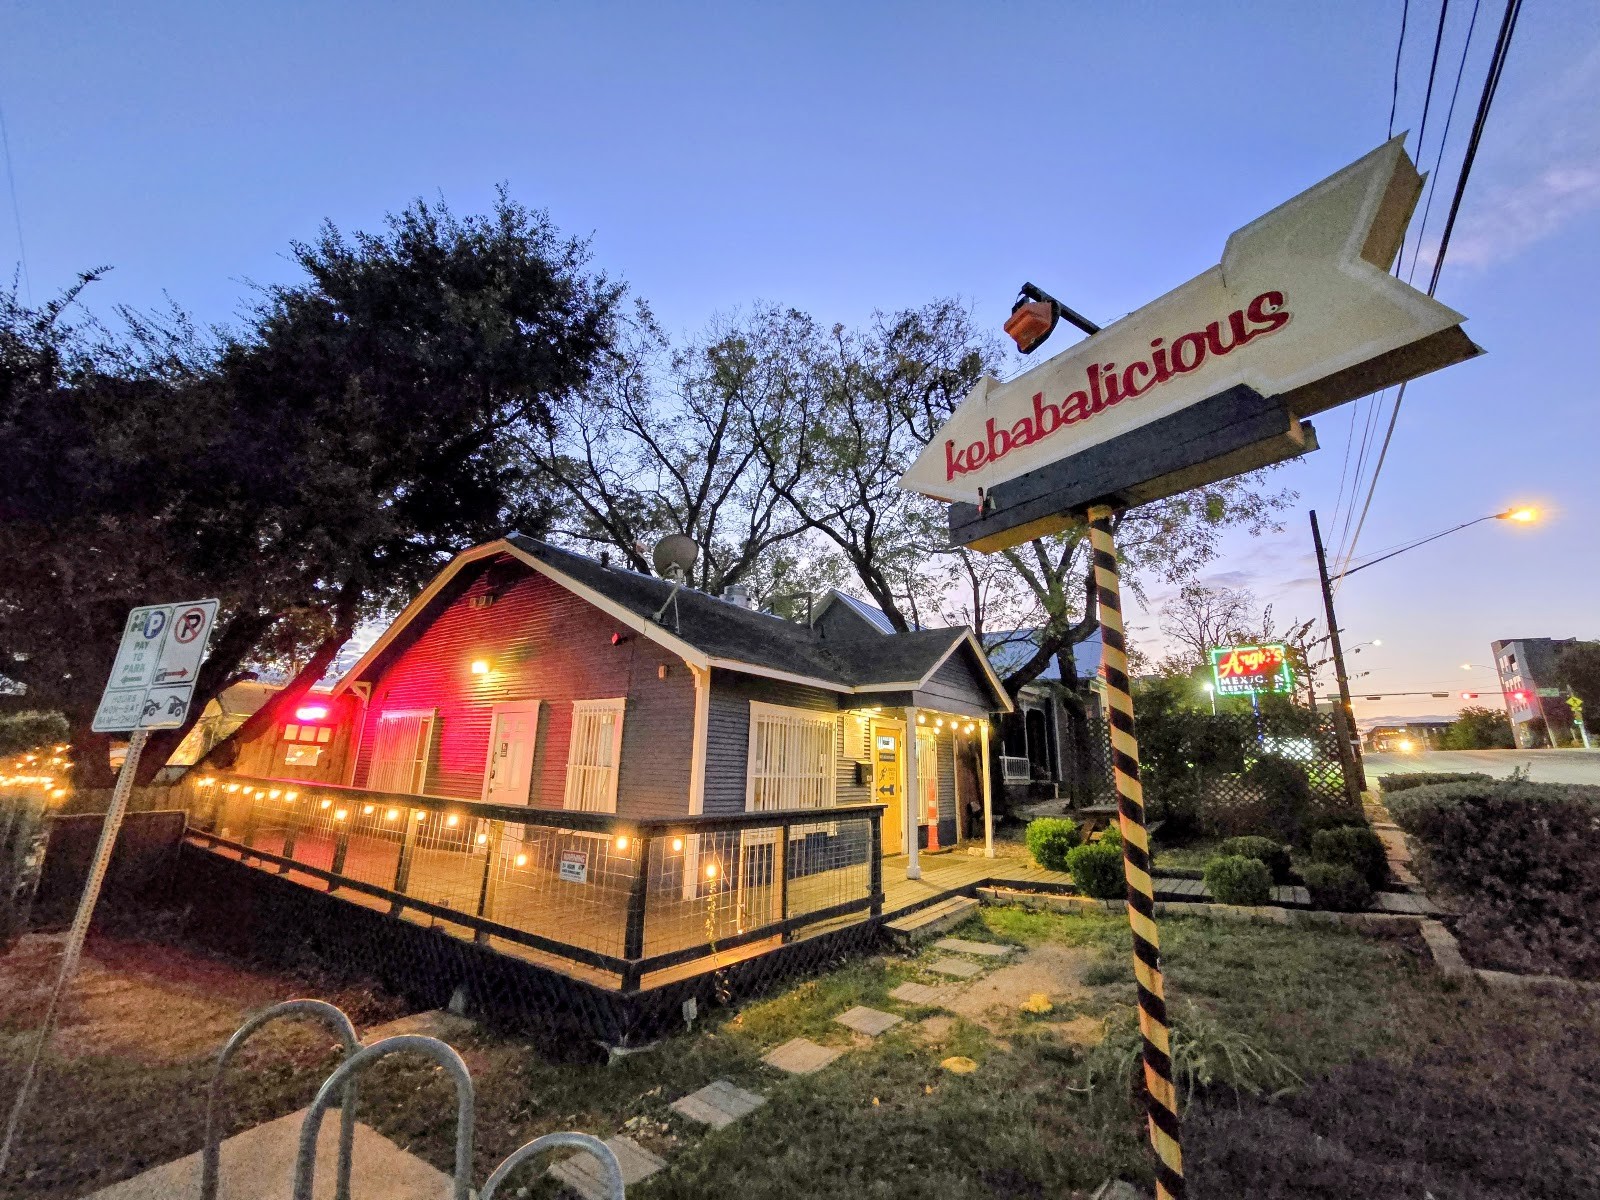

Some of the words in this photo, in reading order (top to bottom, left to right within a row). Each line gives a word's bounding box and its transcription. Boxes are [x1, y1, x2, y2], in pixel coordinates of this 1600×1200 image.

[945, 290, 1291, 481] kebabalicious
[134, 641, 151, 650] PAY
[133, 653, 144, 661] TO
[123, 663, 145, 673] PARK
[1220, 674, 1284, 685] MEXICN
[1220, 682, 1284, 692] RESTAU
